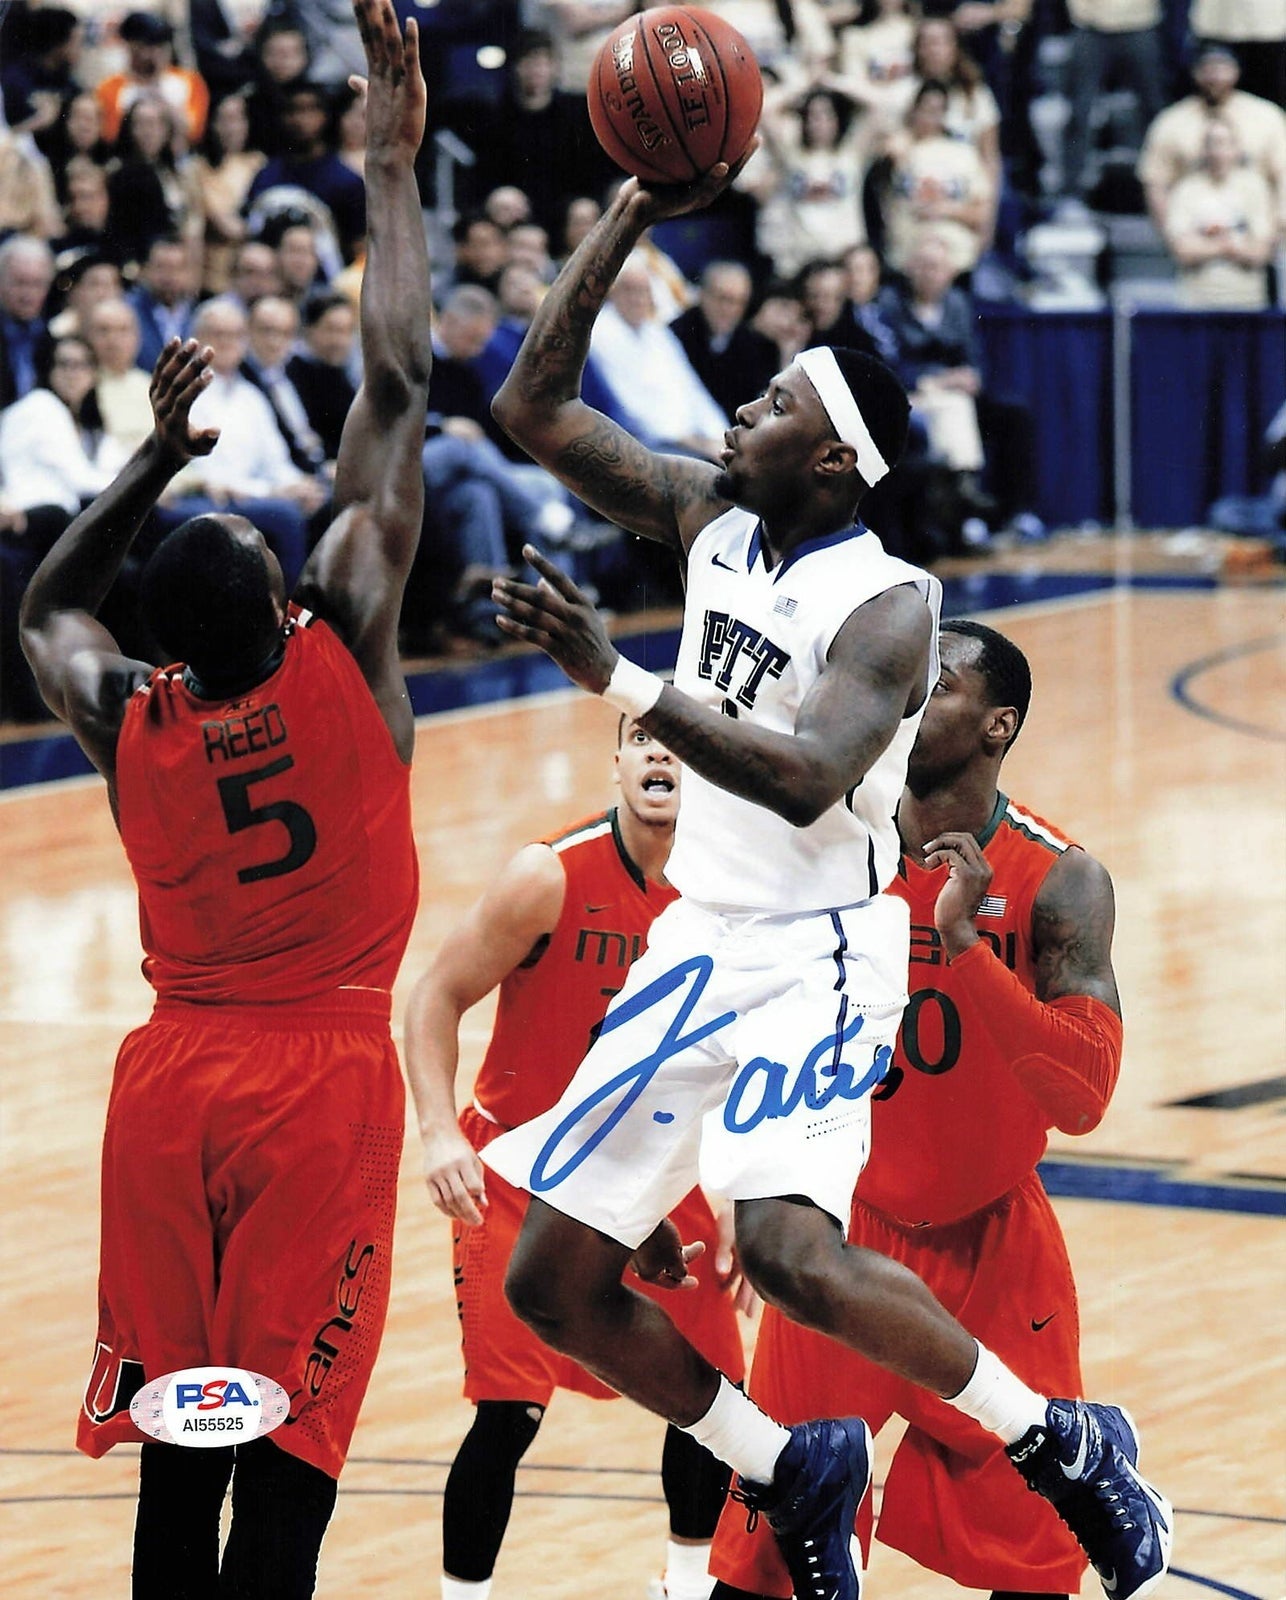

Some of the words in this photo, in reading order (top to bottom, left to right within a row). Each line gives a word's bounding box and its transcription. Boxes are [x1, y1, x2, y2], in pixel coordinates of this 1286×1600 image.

[658, 23, 708, 132] TF-1000
[203, 703, 287, 763] REED
[217, 753, 317, 885] 5
[182, 1417, 244, 1432] AI55525
